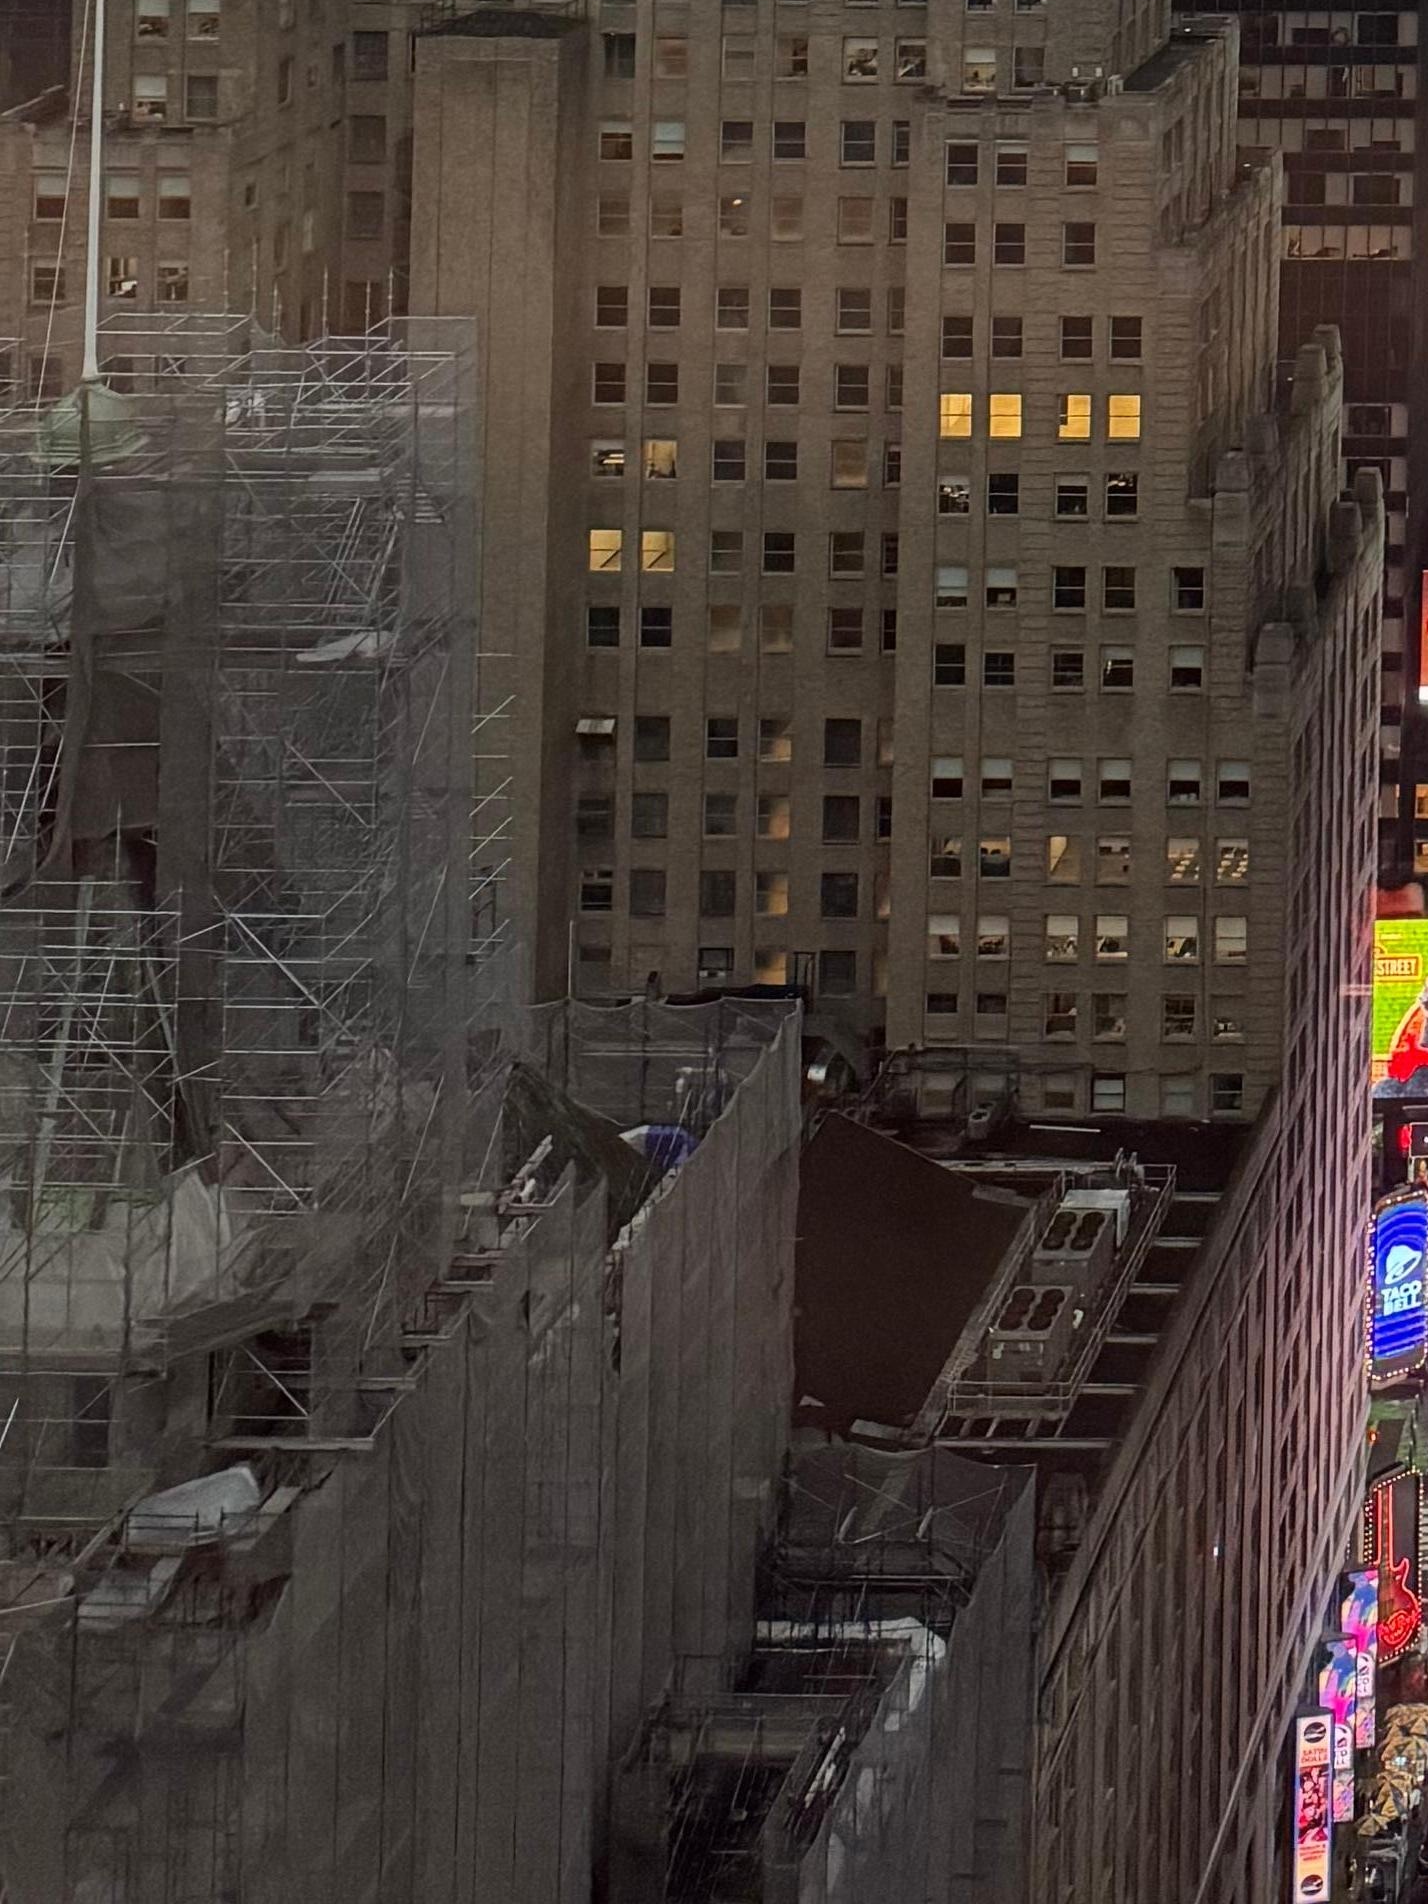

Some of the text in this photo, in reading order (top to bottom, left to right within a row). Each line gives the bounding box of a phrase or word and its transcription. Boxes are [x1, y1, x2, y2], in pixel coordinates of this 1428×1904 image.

[1377, 959, 1417, 976] STREET
[1381, 1280, 1422, 1301] TACO
[1383, 1293, 1422, 1317] BELL
